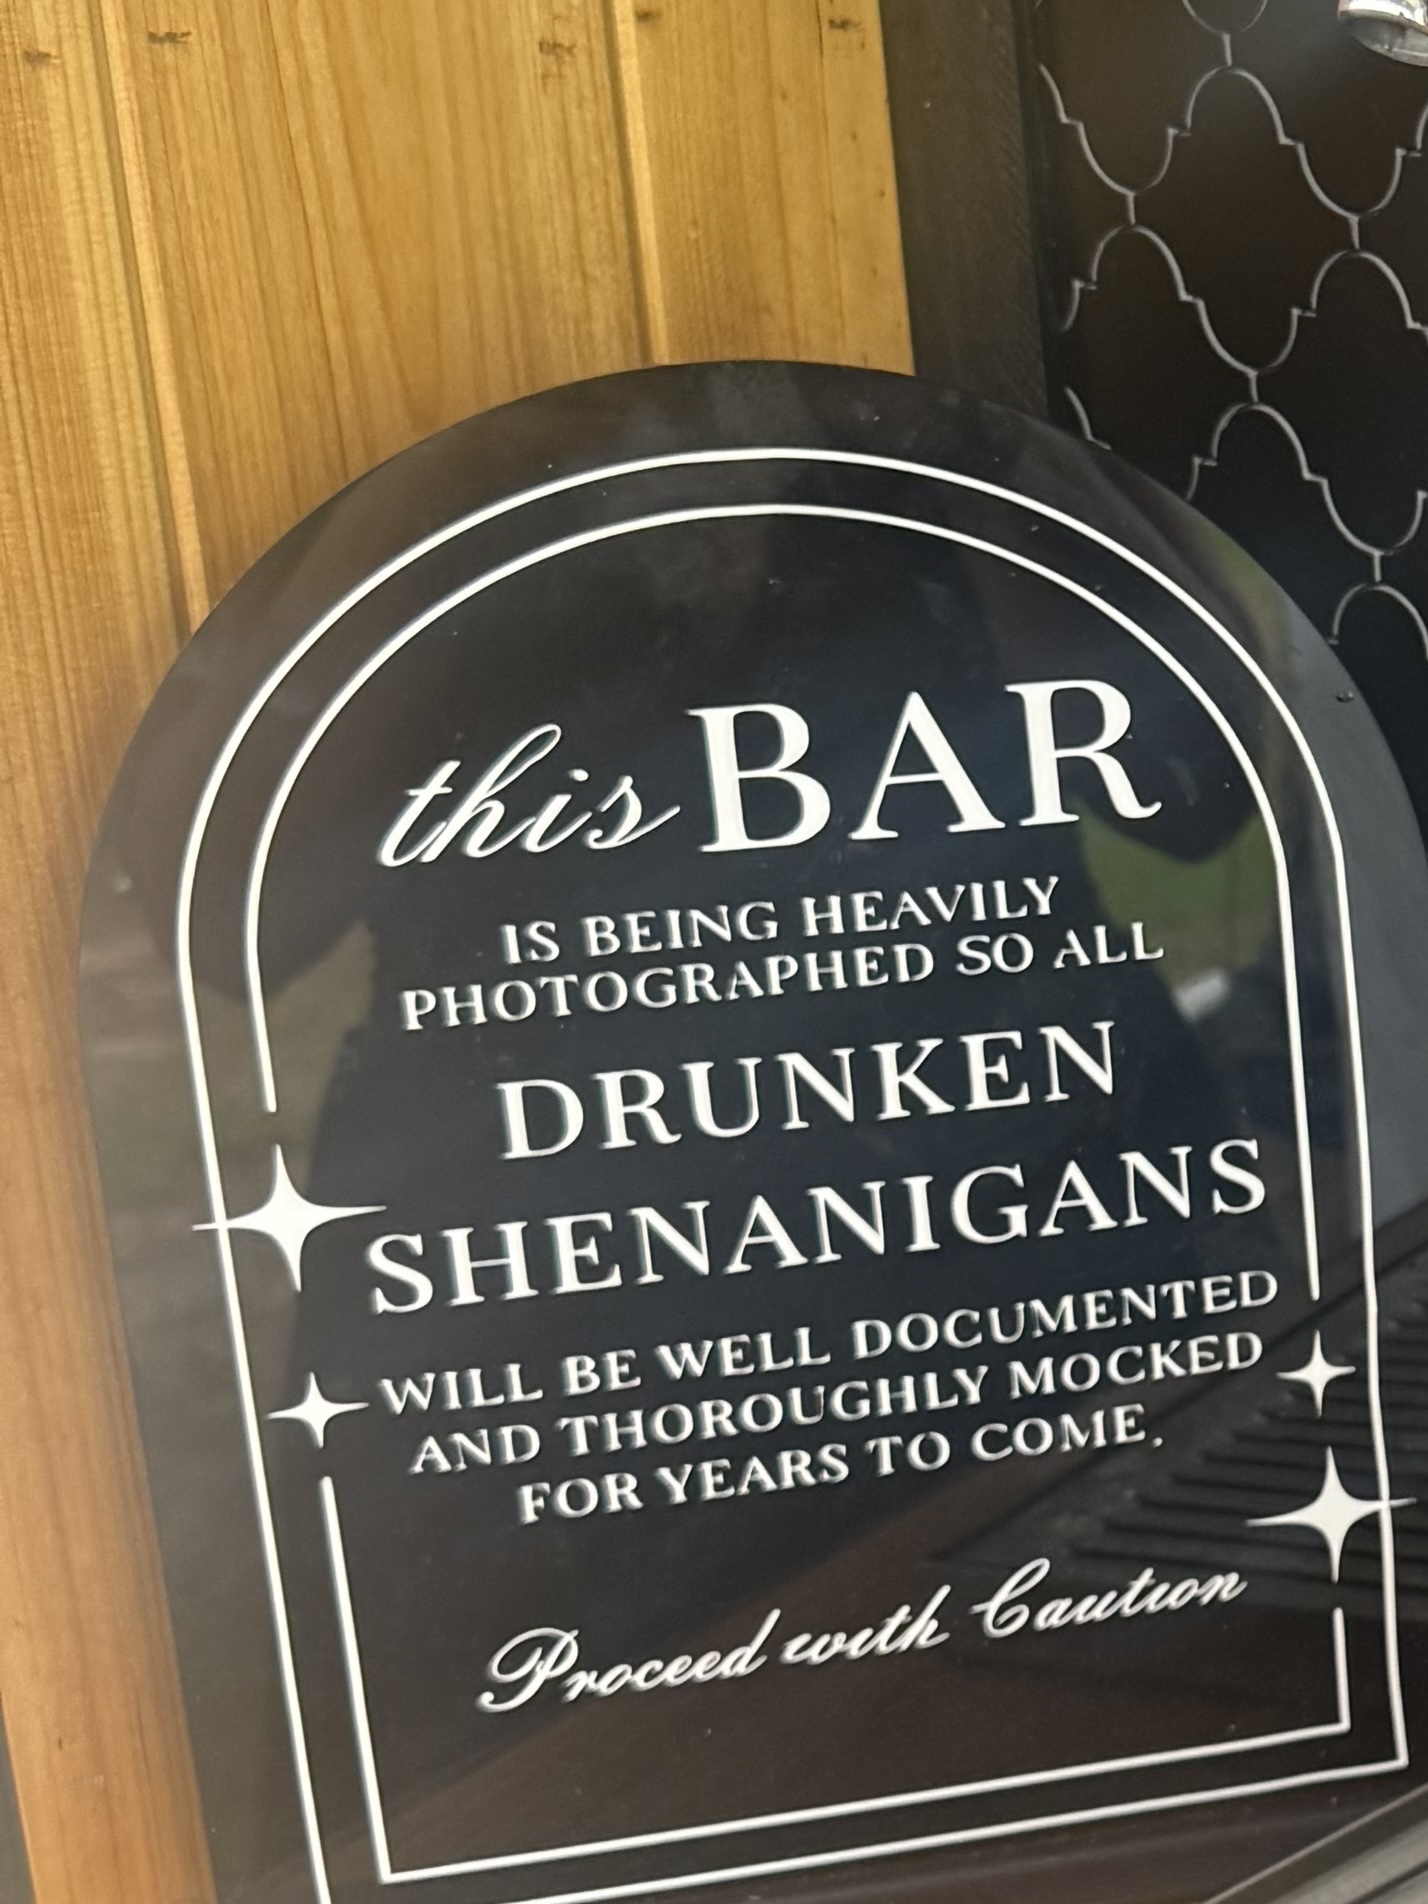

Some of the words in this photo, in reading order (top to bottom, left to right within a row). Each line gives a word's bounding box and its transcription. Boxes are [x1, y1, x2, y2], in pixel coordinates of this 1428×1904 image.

[377, 724, 682, 868] this
[688, 679, 1162, 853] BAR
[400, 943, 934, 1031] PHOTOGRAPHED
[956, 932, 1034, 976] SO
[1053, 921, 1164, 969] ALL
[501, 921, 560, 965] IS
[582, 904, 779, 957] BEING
[801, 876, 1059, 937] HEAVILY
[495, 1020, 1116, 1161] DRUNKEN
[365, 1138, 1266, 1315] SHENANIGANS
[377, 1362, 544, 1415] WILL
[561, 1349, 642, 1396] BE
[655, 1326, 831, 1380] WELL
[851, 1270, 1278, 1359] DOCUMENTED
[409, 1424, 541, 1474] AND
[555, 1365, 989, 1456] THOROUGHLY
[1008, 1331, 1263, 1399] MOCKED
[517, 1472, 644, 1525] FOR
[655, 1443, 850, 1505] YEARS
[865, 1431, 951, 1476] TO
[971, 1403, 1164, 1462] COME.
[477, 1608, 782, 1713] Proceed
[780, 1584, 952, 1665] with
[971, 1557, 1248, 1638] Caution
